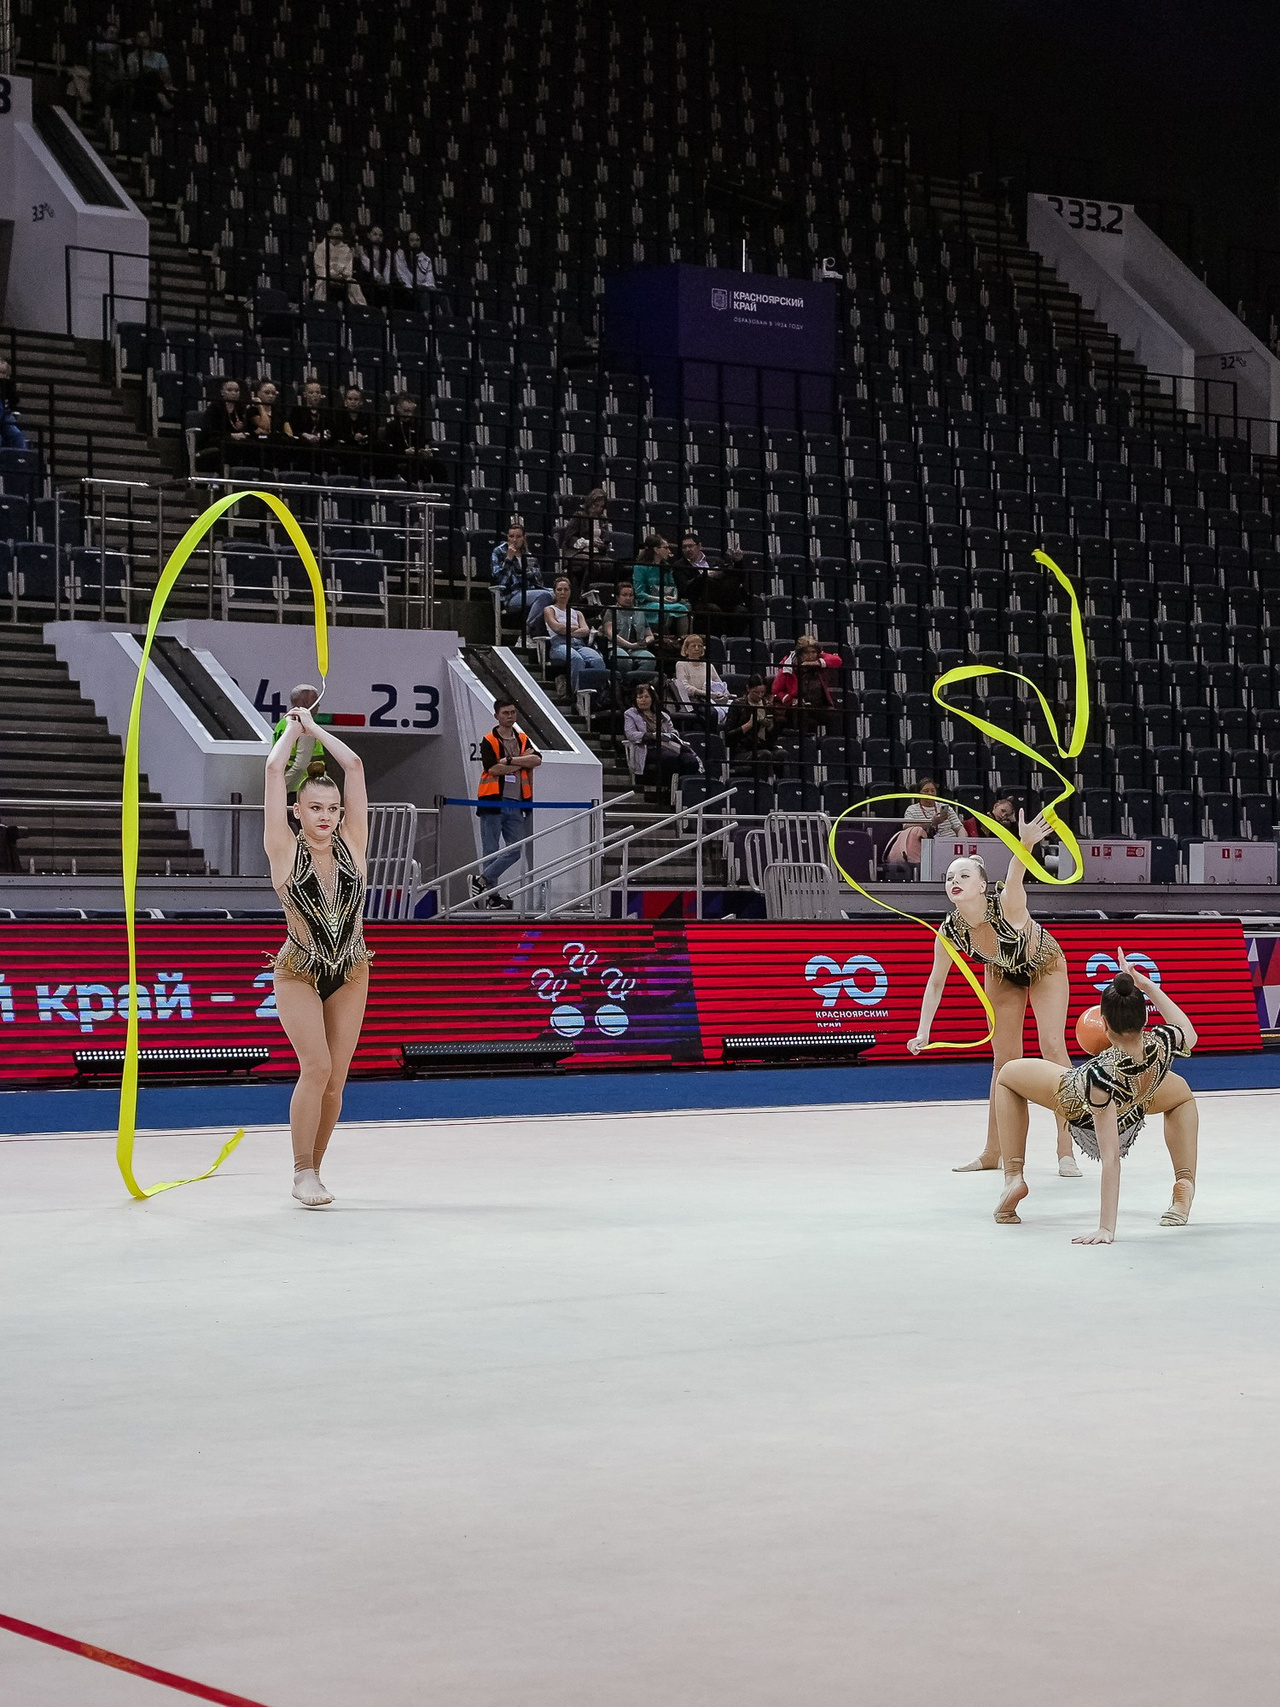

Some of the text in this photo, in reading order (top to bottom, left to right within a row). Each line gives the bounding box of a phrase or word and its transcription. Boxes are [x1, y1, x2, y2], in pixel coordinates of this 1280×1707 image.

[733, 291, 804, 308] КРАСНОЯРСКИЙ
[733, 301, 757, 312] КРАЙ
[369, 683, 440, 729] 2.3
[35, 972, 195, 1033] край
[804, 954, 889, 1007] 90
